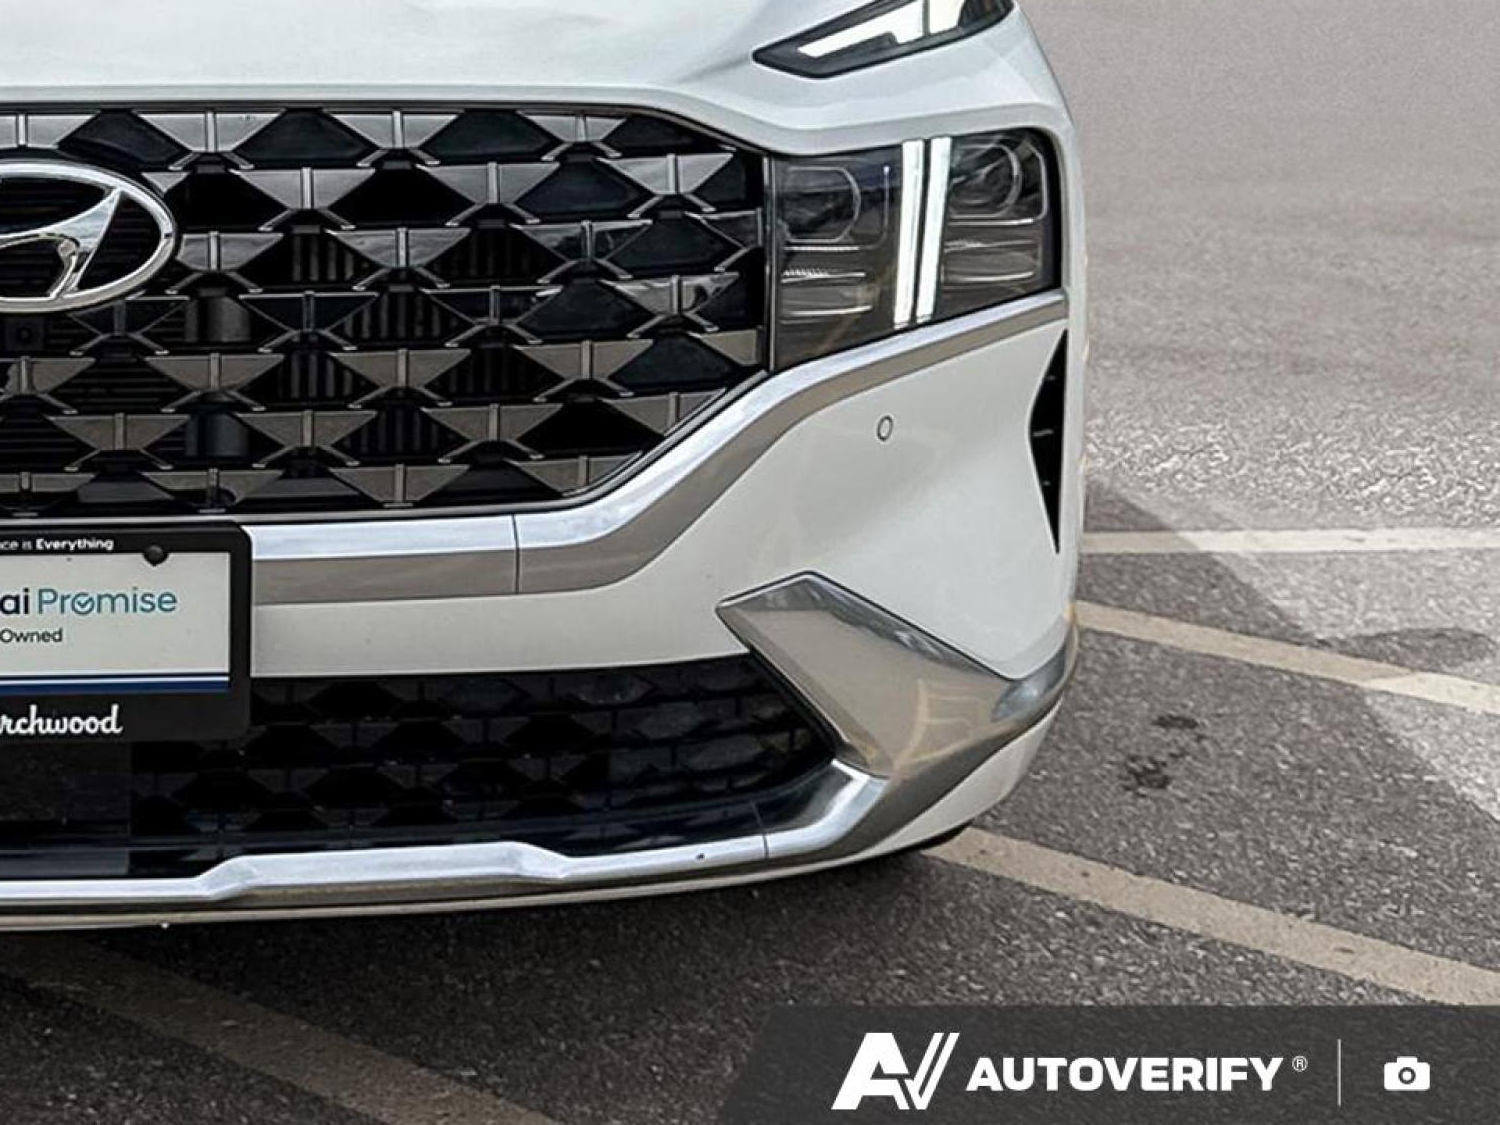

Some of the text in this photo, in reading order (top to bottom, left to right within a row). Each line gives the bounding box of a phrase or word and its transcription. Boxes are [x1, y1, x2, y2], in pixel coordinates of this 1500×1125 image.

[23, 539, 32, 550] is
[36, 537, 114, 551] Everything
[38, 586, 177, 615] Promise
